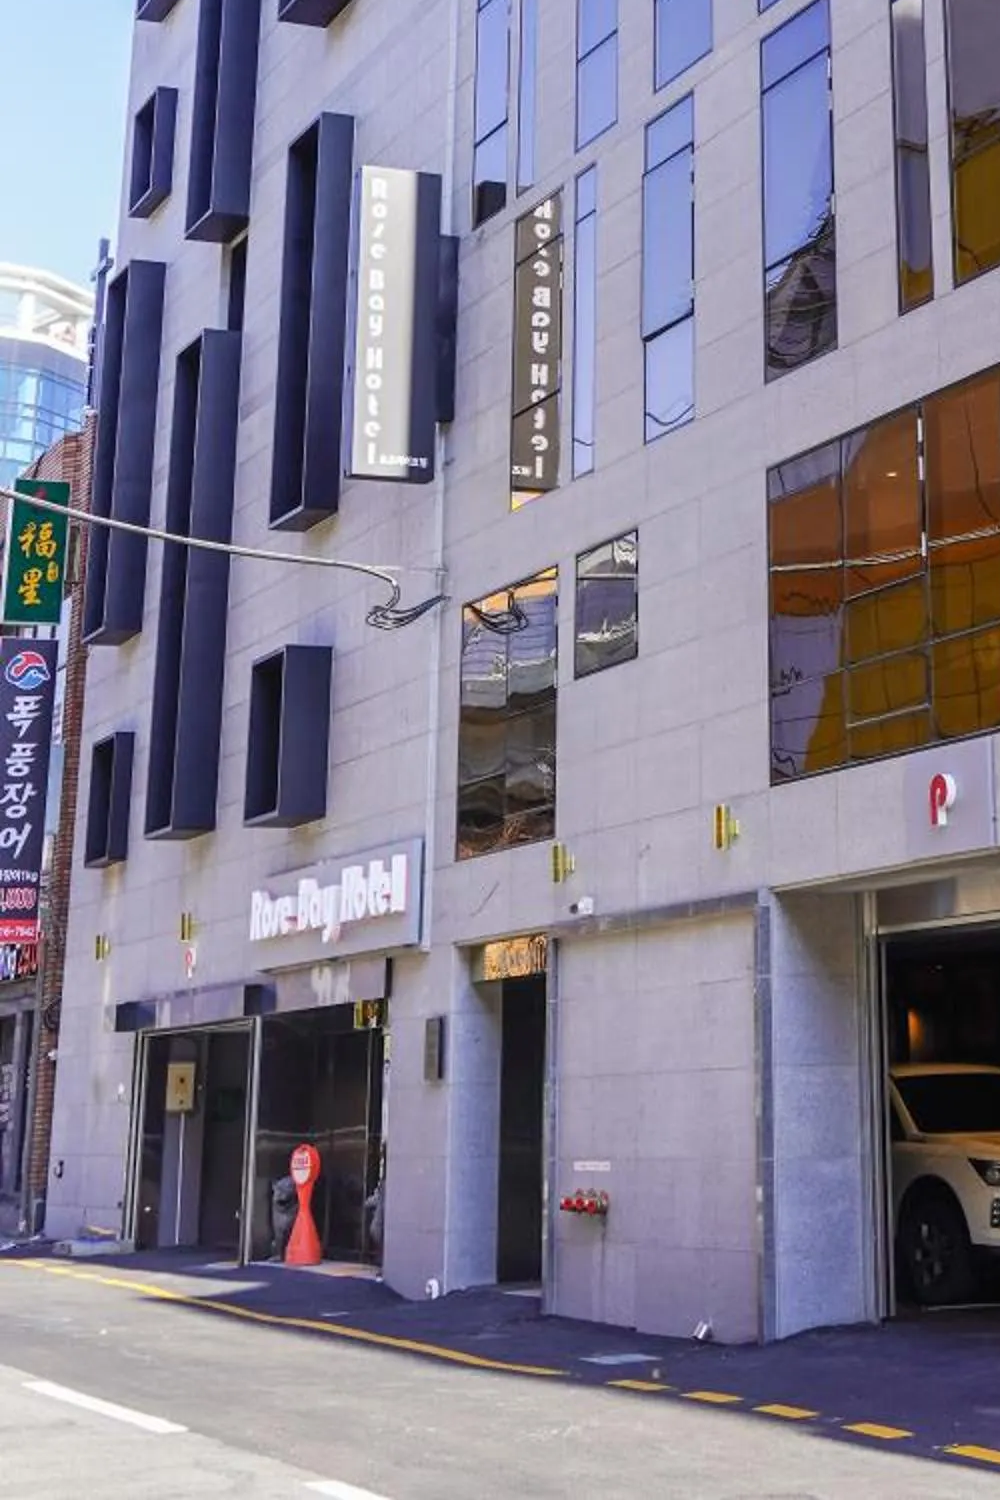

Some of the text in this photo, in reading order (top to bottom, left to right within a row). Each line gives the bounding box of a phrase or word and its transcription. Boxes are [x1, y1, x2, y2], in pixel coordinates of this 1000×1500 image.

[364, 178, 389, 466] Rose Bay Hotel
[0, 695, 44, 859] 폭풍장어
[929, 772, 957, 828] P
[249, 853, 407, 943] Rose Bay Hotel
